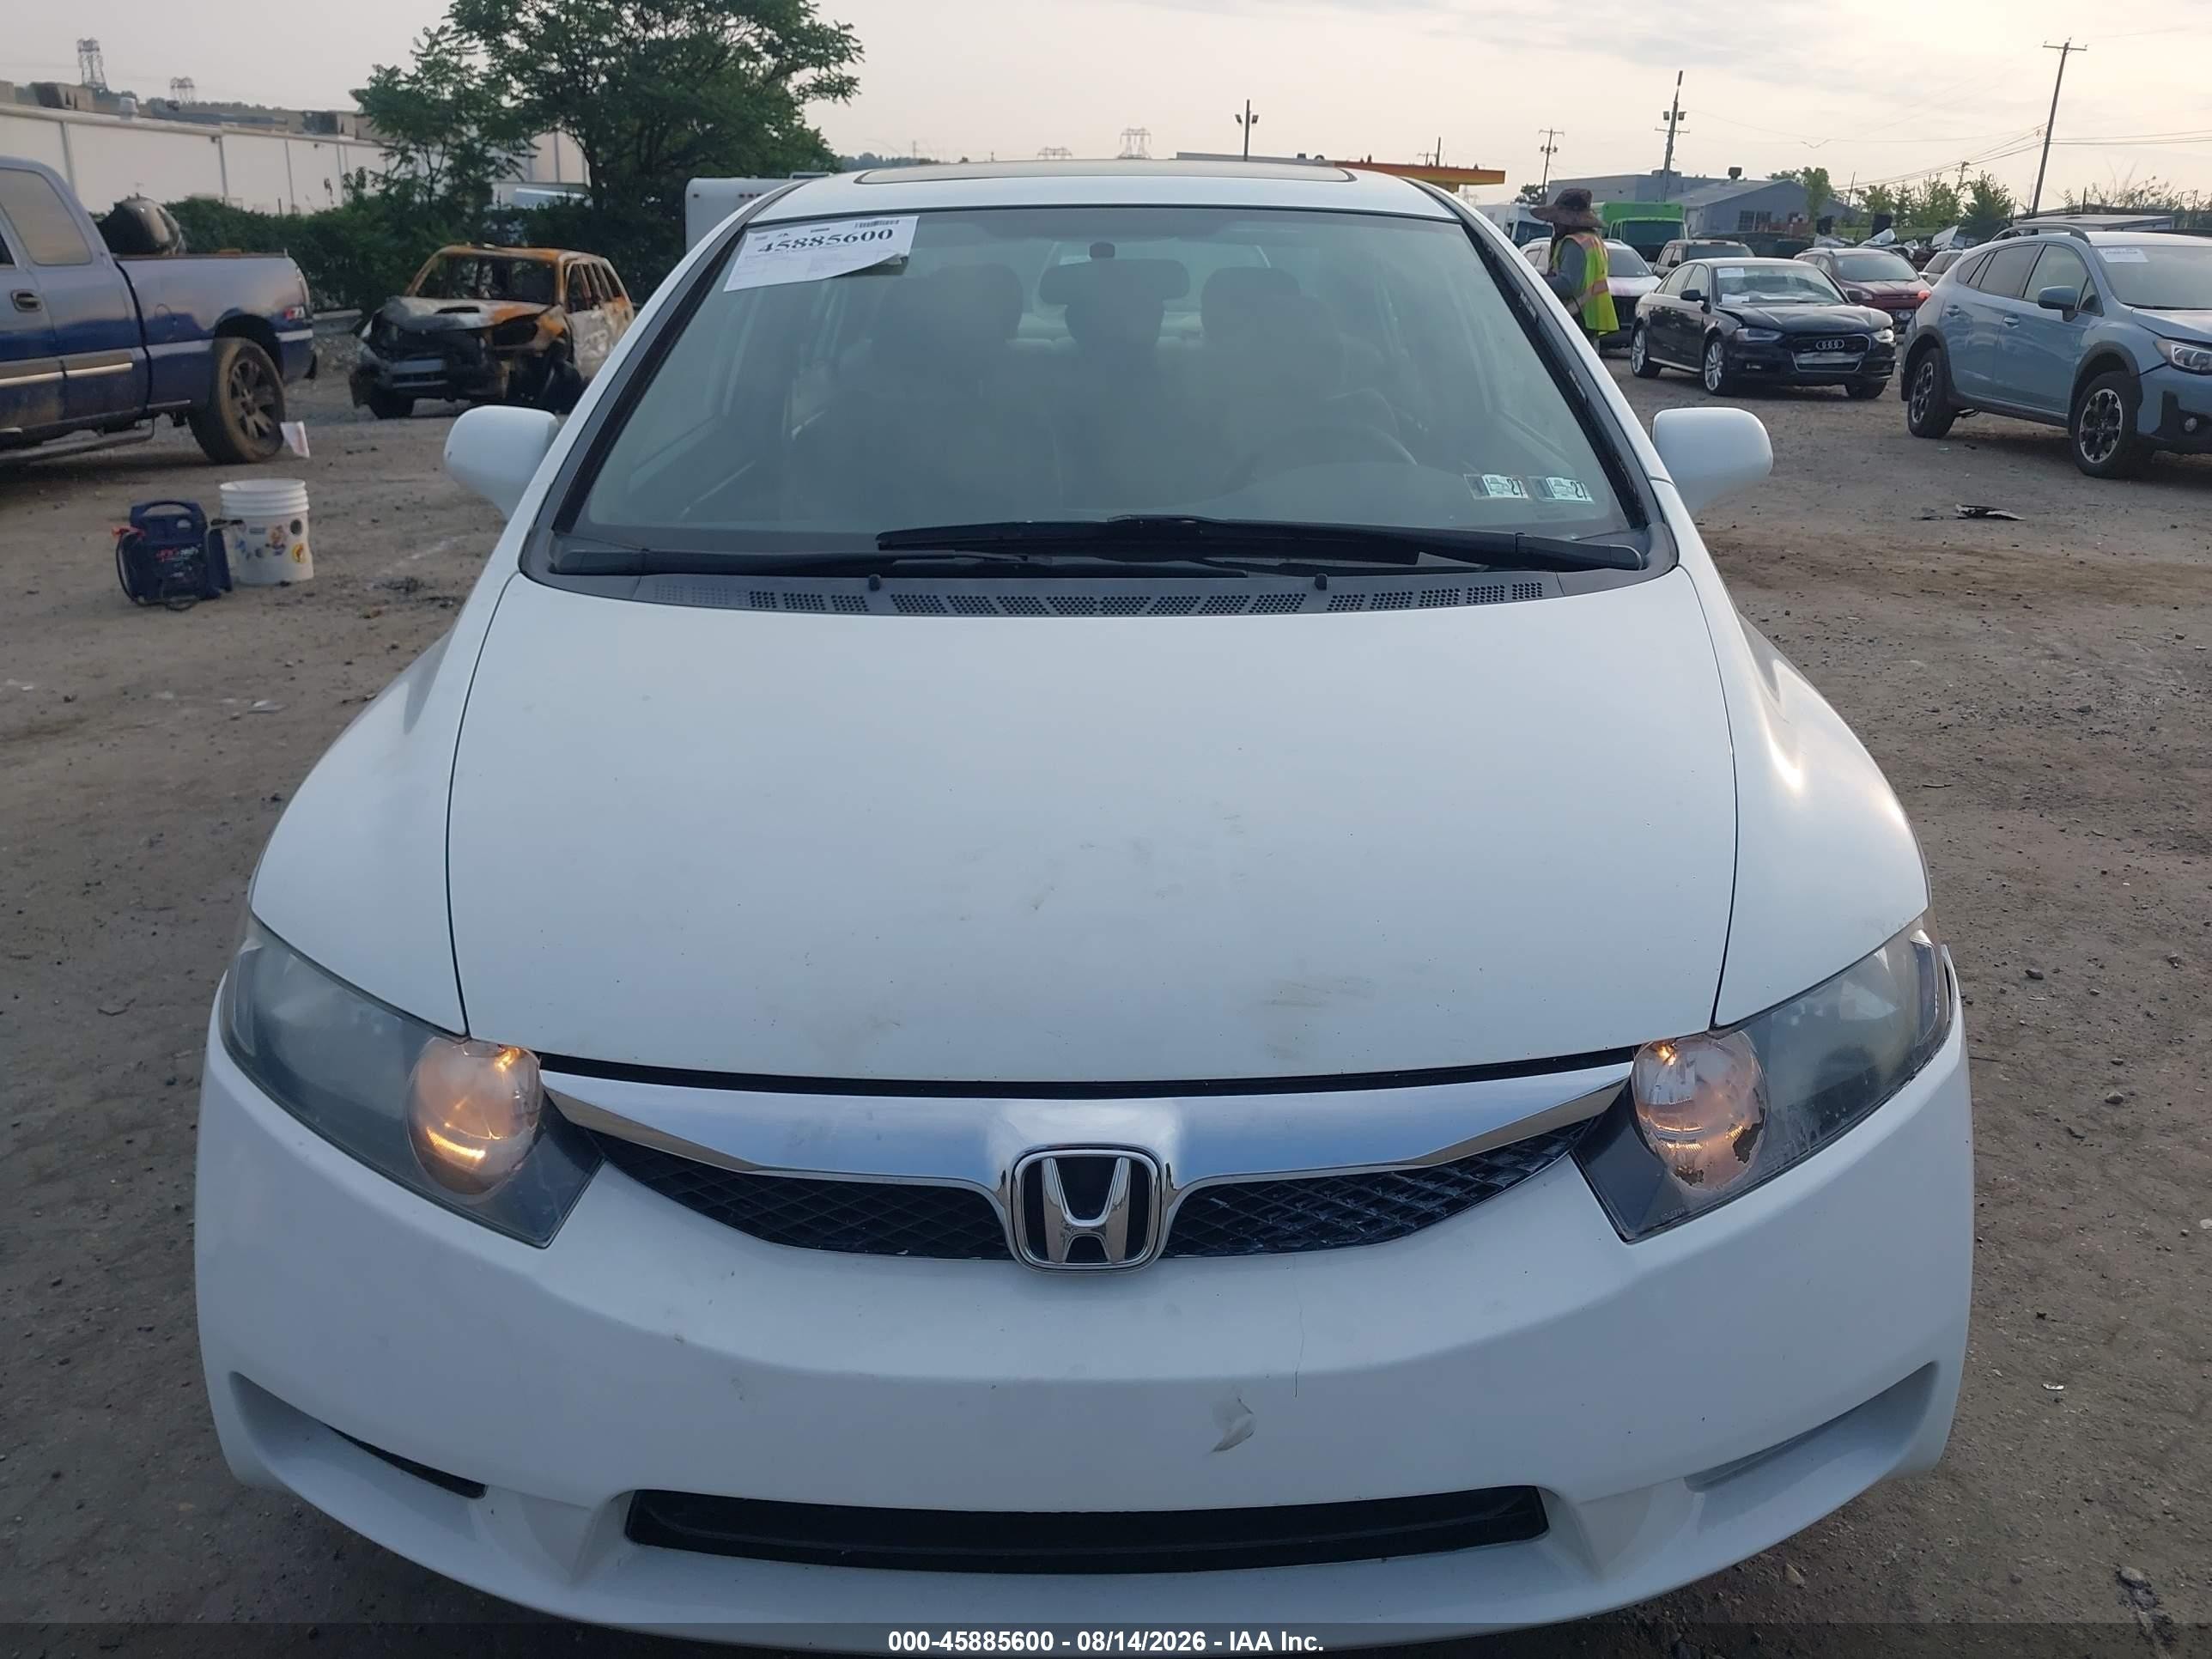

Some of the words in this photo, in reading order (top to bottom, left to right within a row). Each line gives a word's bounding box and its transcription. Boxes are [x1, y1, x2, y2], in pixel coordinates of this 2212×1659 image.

[757, 228, 893, 252] 45885600
[1507, 478, 1523, 496] 21
[1570, 481, 1588, 500] 21
